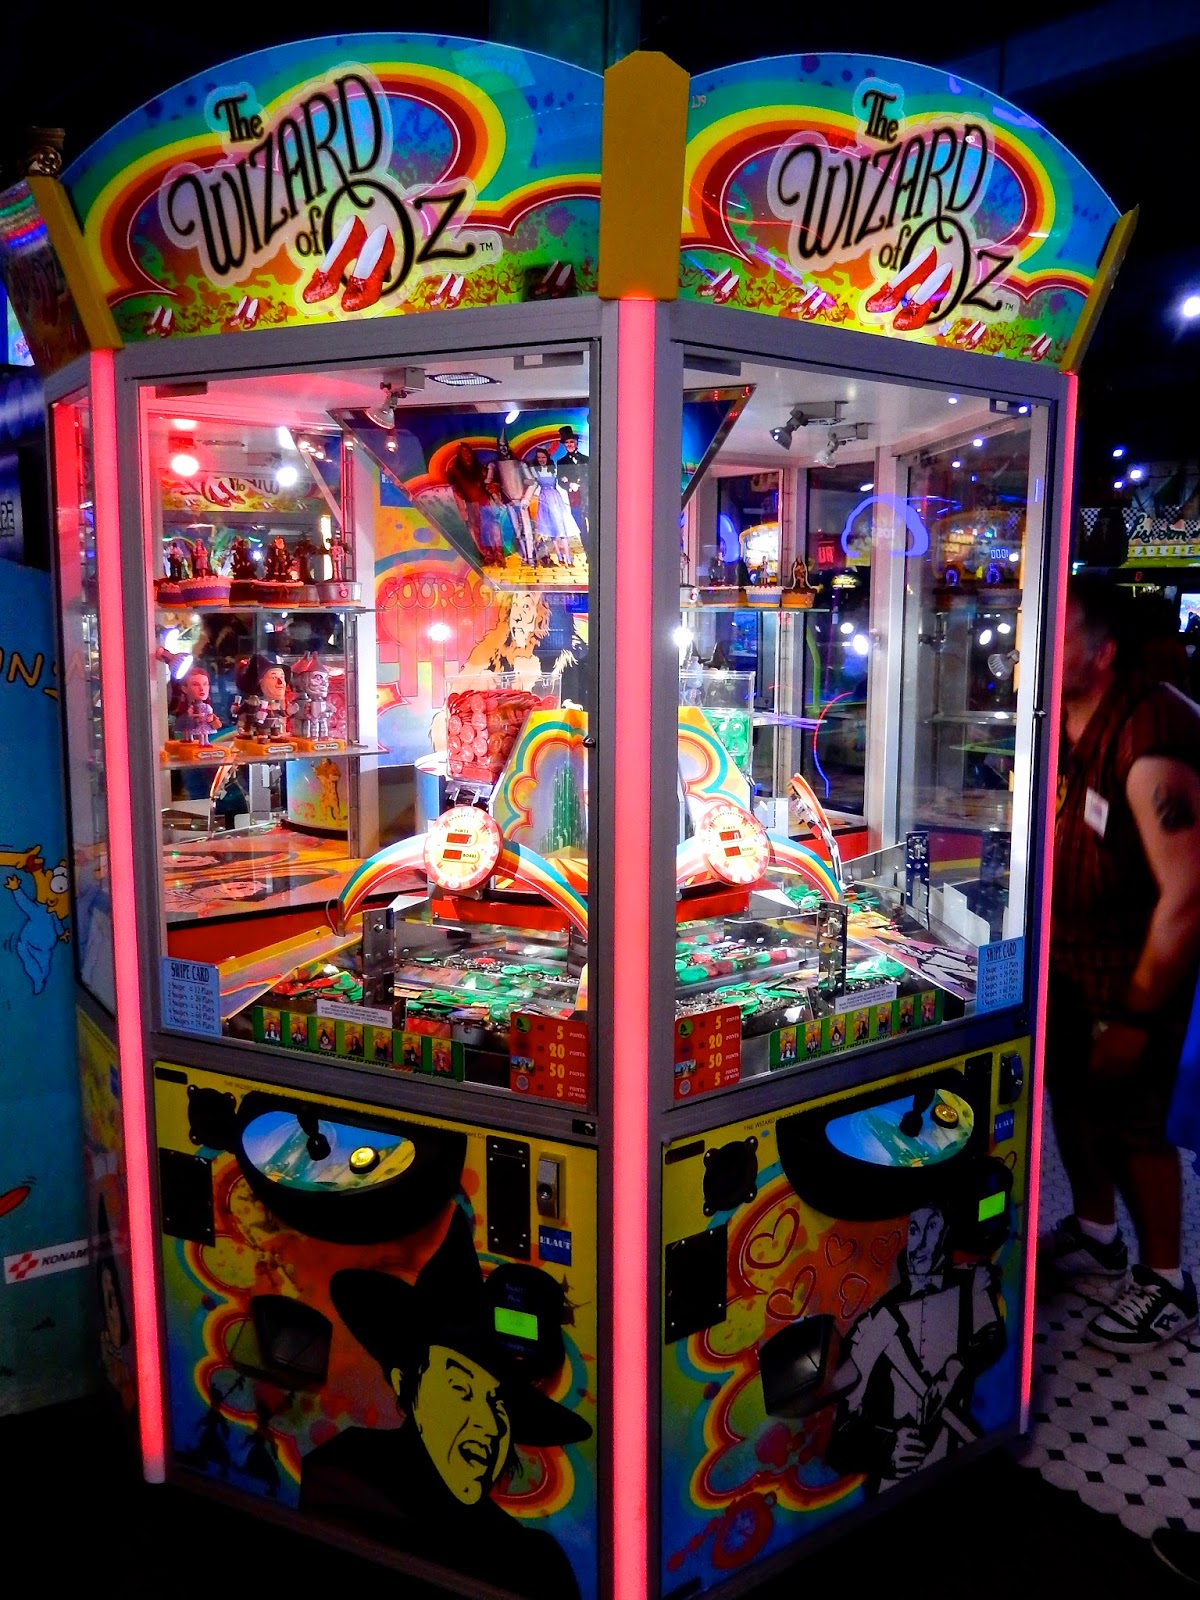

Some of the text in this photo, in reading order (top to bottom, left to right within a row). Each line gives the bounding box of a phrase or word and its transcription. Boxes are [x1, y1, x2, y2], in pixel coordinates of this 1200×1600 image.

[214, 93, 264, 142] The
[861, 90, 899, 143] The
[167, 73, 383, 274] WIZARD
[777, 124, 988, 259] WIZARD
[295, 208, 324, 257] of
[879, 224, 911, 271] of
[171, 962, 210, 982] SWIPE CARD
[715, 1015, 721, 1030] 5
[556, 1025, 564, 1040] 5
[709, 1032, 722, 1049] 20
[549, 1042, 565, 1059] 20
[709, 1052, 722, 1068] 50
[550, 1062, 565, 1078] 50
[714, 1072, 721, 1086] 5
[556, 1083, 564, 1098] 5
[539, 1235, 570, 1250] ELAUT
